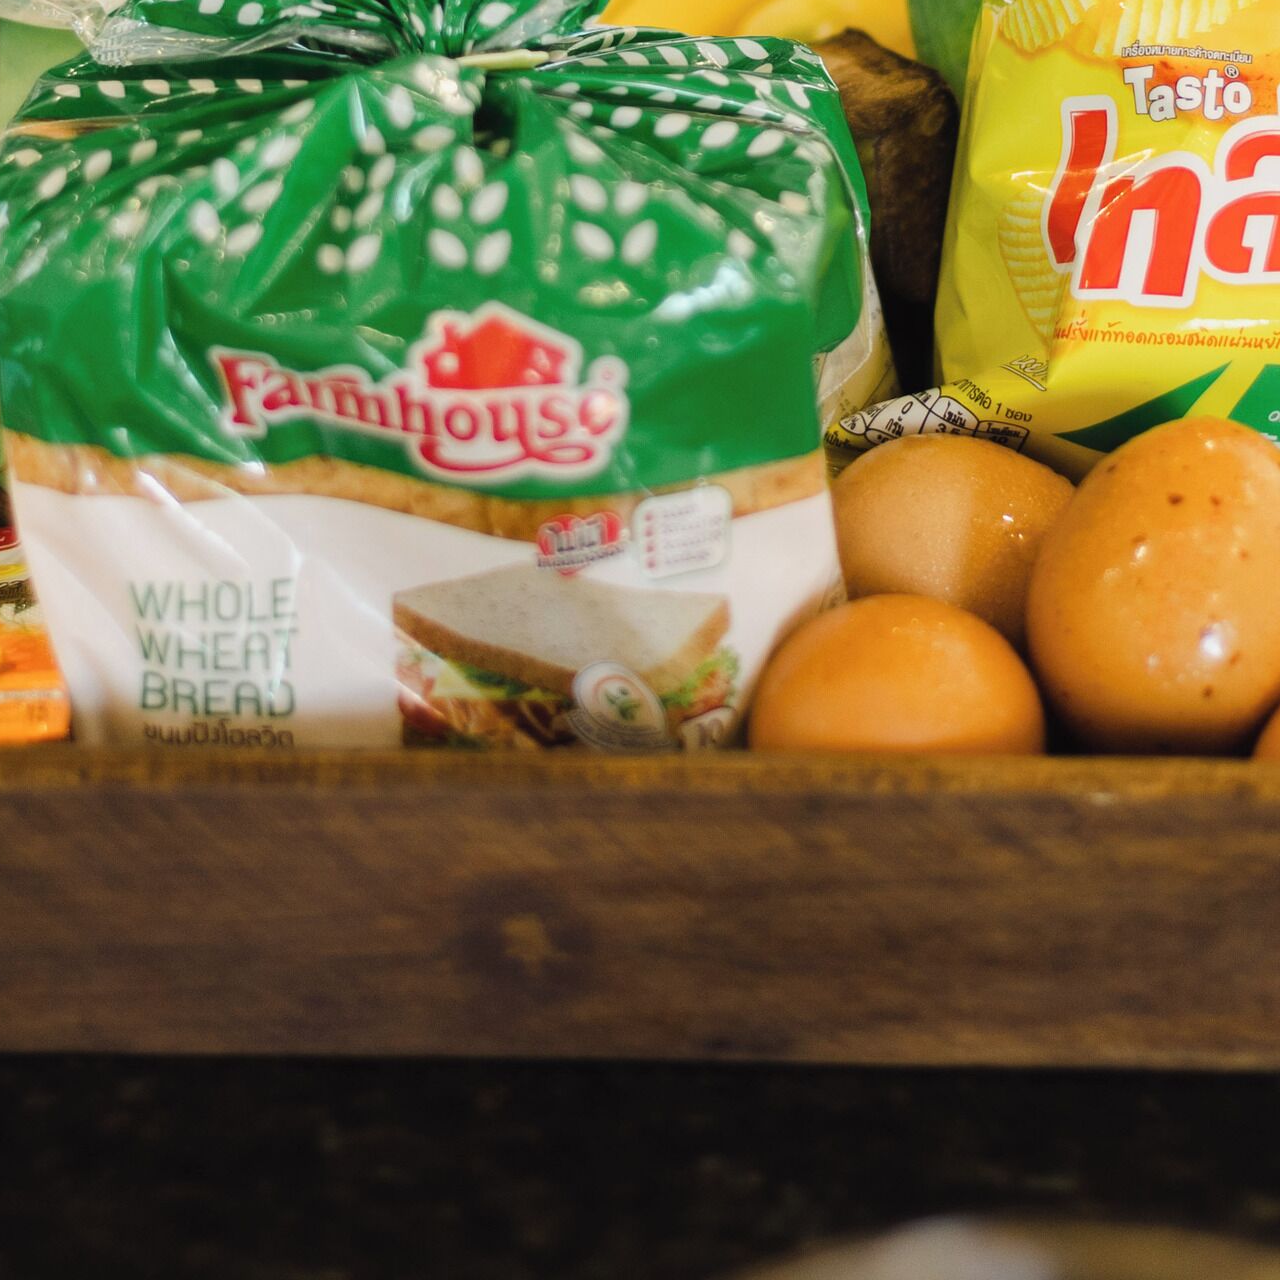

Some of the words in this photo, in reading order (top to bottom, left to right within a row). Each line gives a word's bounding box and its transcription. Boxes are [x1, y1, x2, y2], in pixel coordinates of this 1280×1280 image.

[1123, 64, 1252, 122] Tasto
[215, 354, 618, 473] Farmhouse
[1005, 409, 1033, 423] ซอง
[128, 578, 298, 622] WHOLE
[135, 625, 299, 672] WHEAT
[141, 670, 297, 718] BREAD
